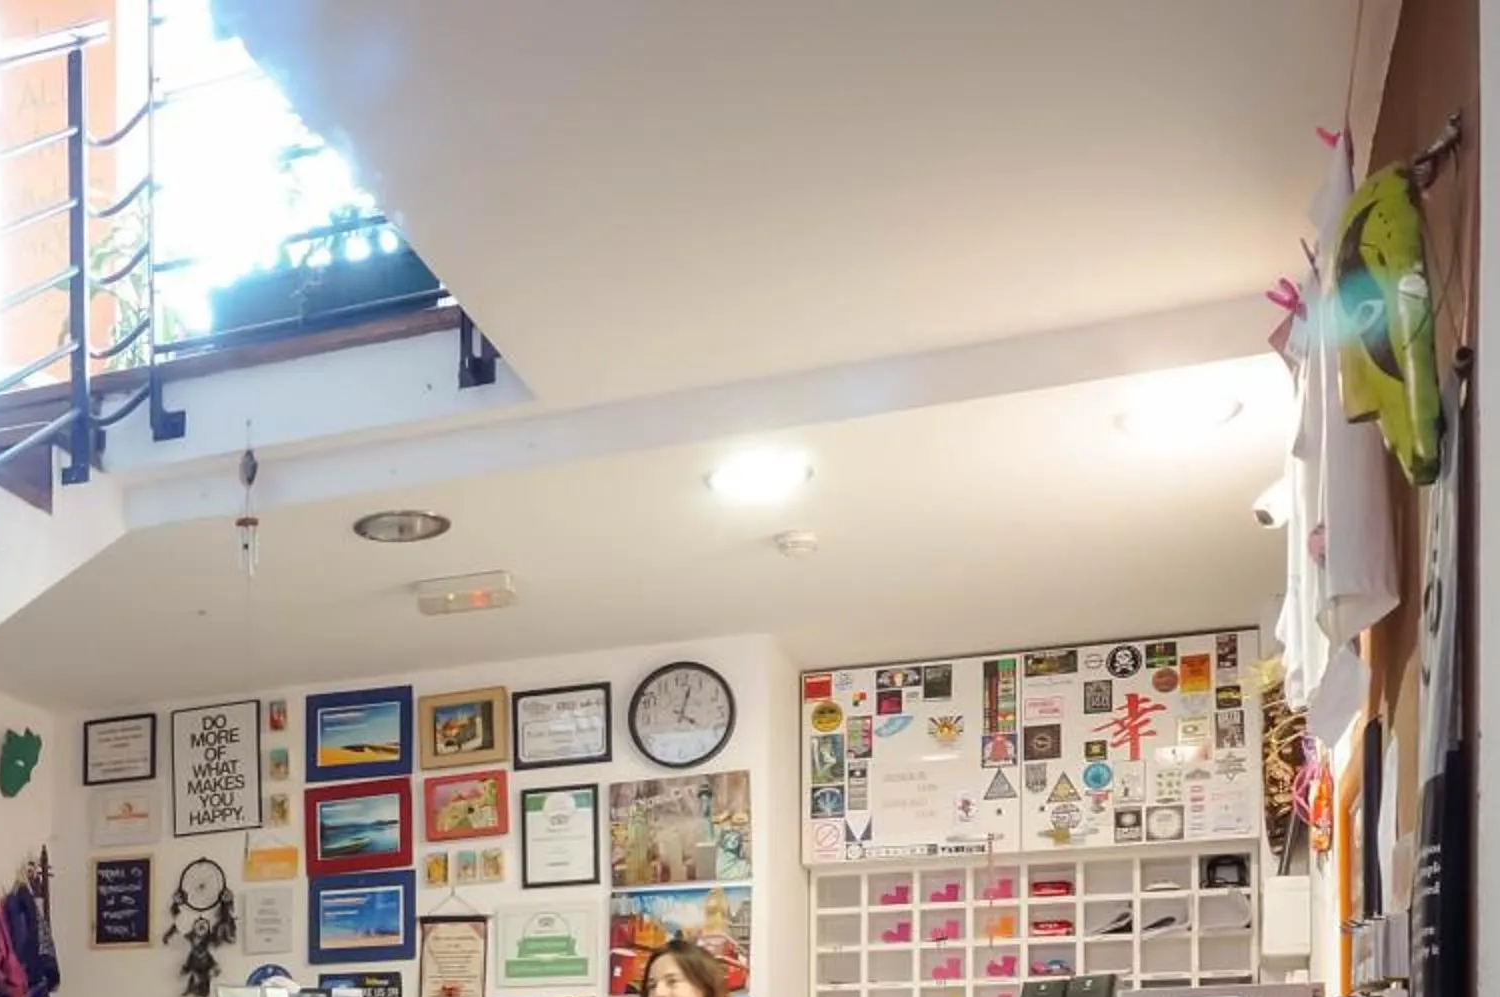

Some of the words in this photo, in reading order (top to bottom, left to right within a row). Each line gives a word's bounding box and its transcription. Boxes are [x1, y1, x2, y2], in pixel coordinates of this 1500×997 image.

[203, 714, 227, 731] DO
[190, 728, 240, 749] MORE
[204, 747, 227, 761] OF
[192, 759, 238, 779] WHAT
[187, 774, 245, 795] MAKES
[199, 793, 235, 808] YOU
[189, 807, 245, 826] HAPPY.
